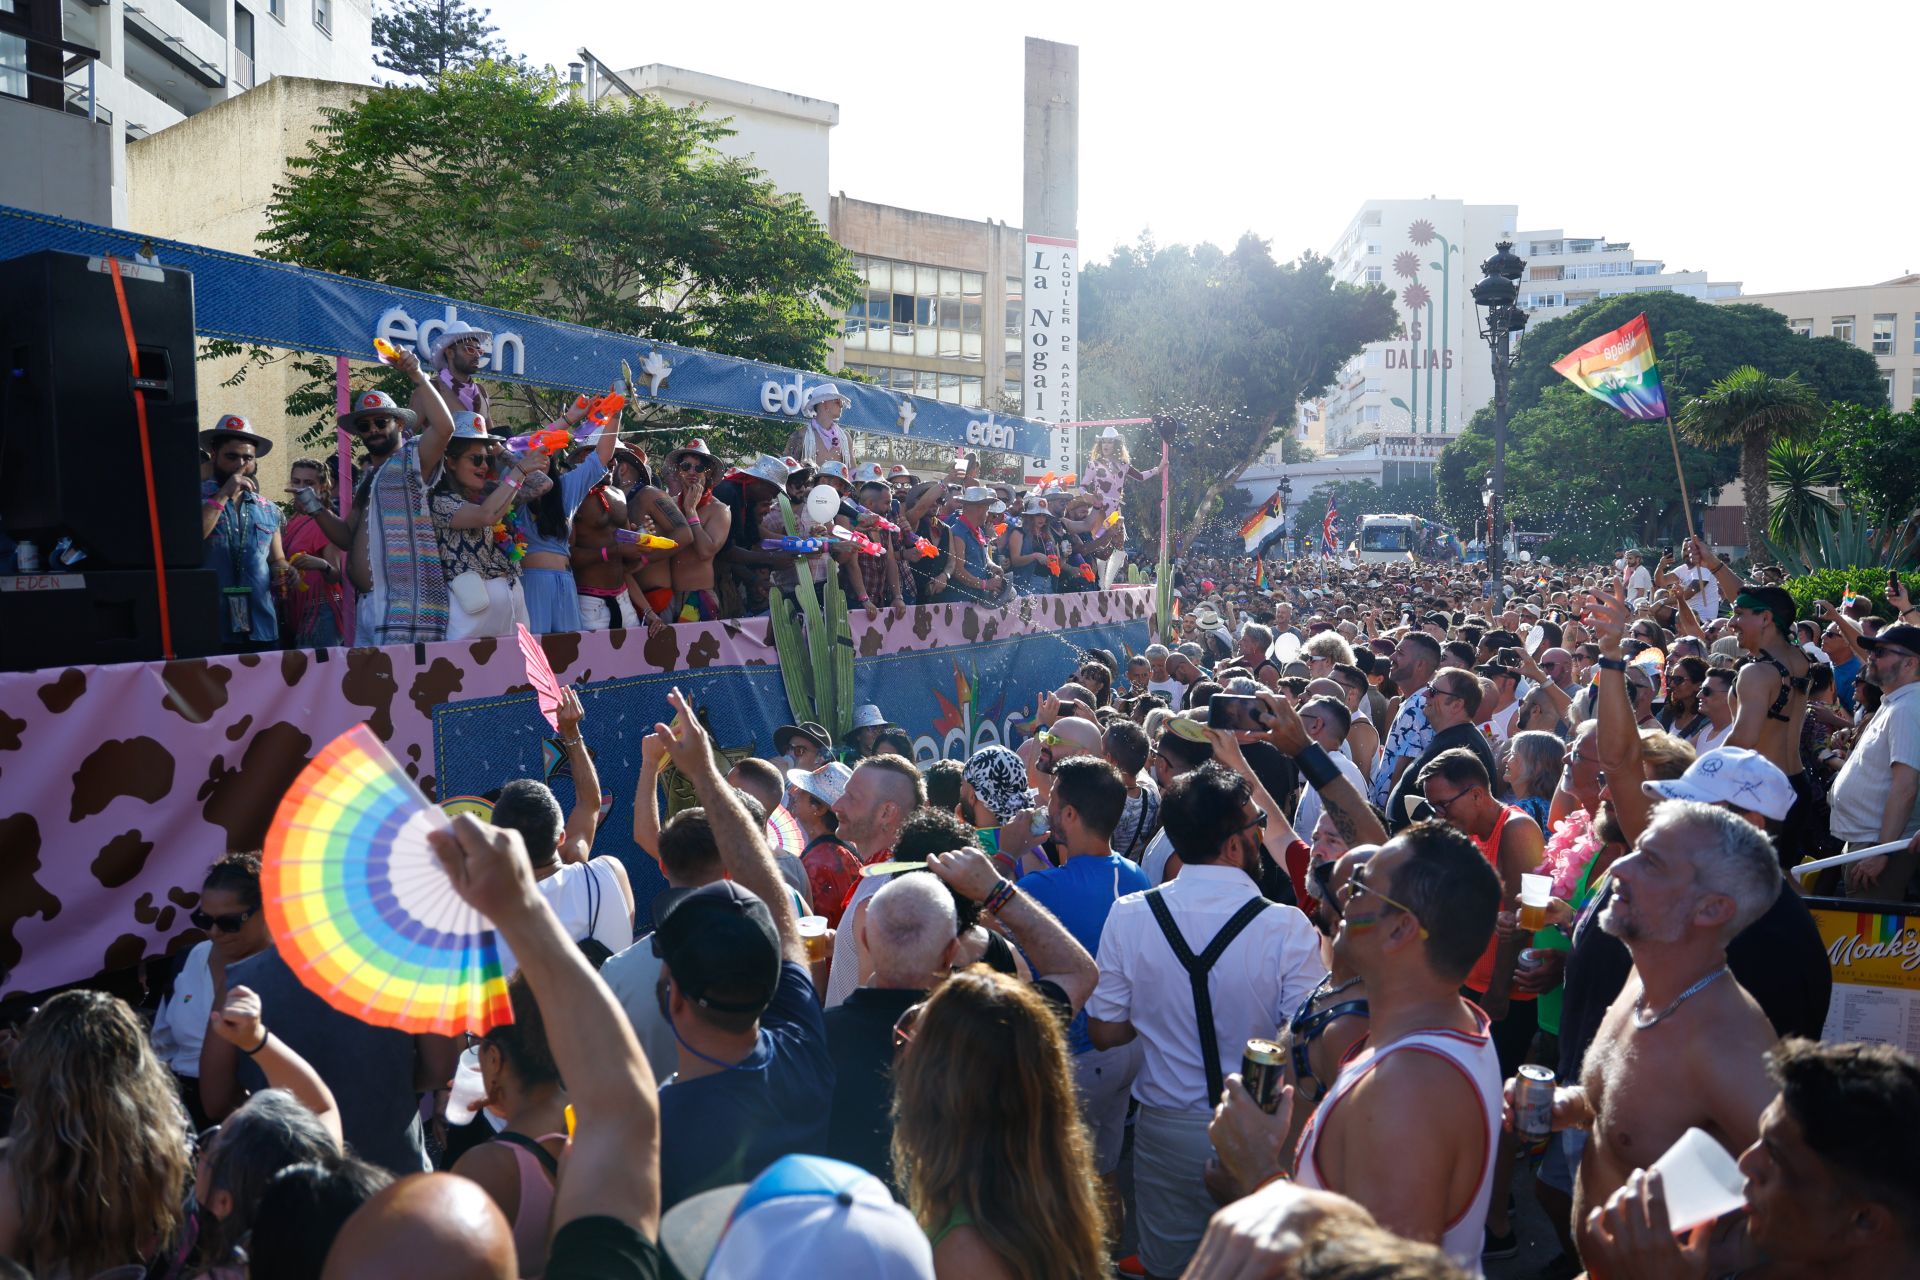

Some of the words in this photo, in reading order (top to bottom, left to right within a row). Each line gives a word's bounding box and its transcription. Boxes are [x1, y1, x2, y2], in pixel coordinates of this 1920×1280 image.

[100, 259, 140, 278] EEN
[1032, 251, 1050, 289] La
[1061, 253, 1071, 325] ALQUILER
[1061, 335, 1071, 352] DE
[1385, 348, 1453, 369] DALIAS
[1030, 308, 1054, 469] Nogala
[966, 413, 1015, 450] eden
[15, 575, 61, 590] EDEN
